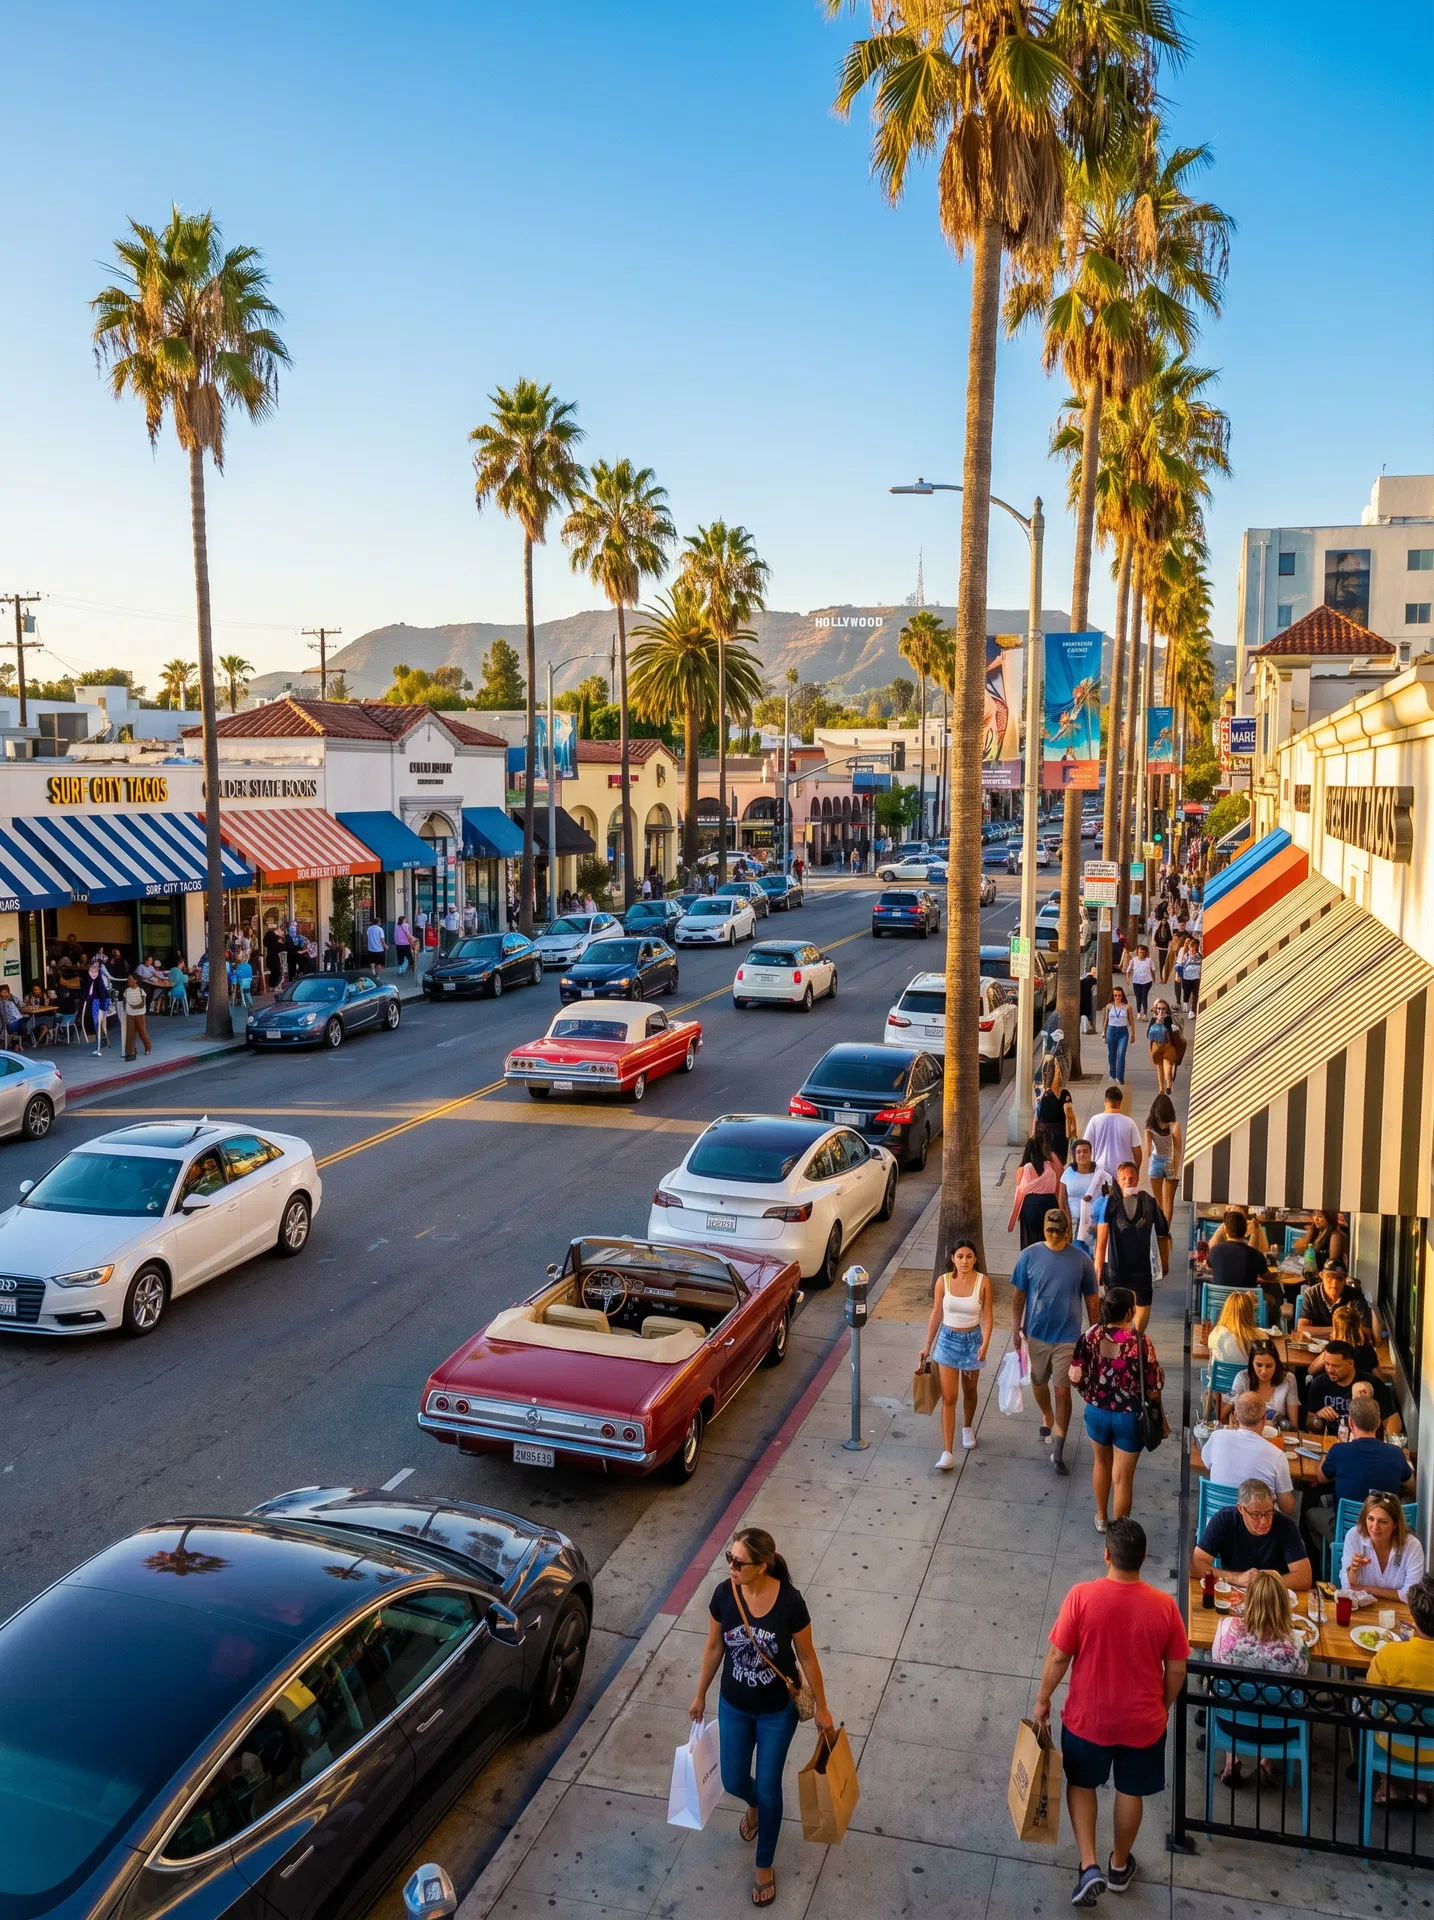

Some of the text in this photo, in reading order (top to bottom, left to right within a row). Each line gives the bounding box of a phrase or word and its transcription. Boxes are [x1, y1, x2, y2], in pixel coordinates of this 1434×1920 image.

[815, 617, 884, 628] HOLLYWOOD
[47, 777, 168, 804] SURF CITY TACOS
[282, 780, 317, 797] BOOKS
[163, 883, 178, 893] CITY
[180, 880, 202, 892] TACOS
